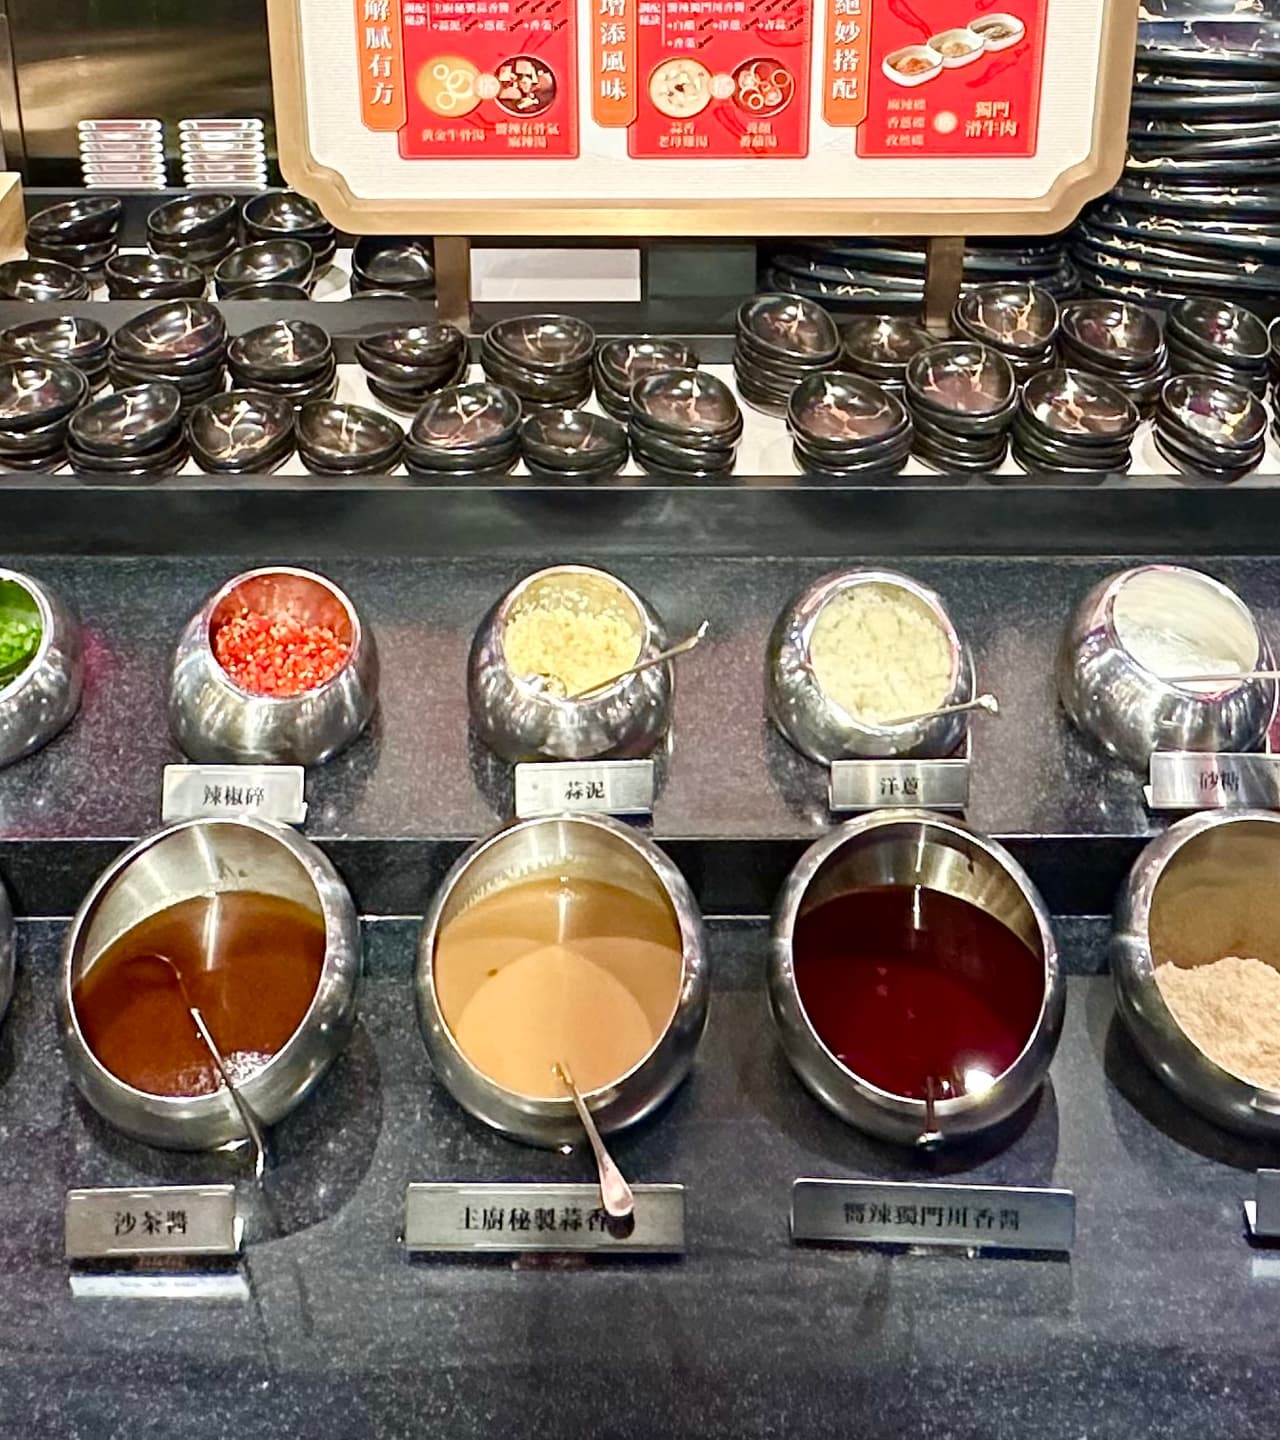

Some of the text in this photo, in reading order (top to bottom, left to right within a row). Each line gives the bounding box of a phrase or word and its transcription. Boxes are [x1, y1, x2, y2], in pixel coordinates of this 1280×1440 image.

[564, 779, 606, 801] 蒜泥
[113, 1208, 189, 1236] 沙茶醬
[455, 1206, 634, 1233] 主廚秘製蒜香
